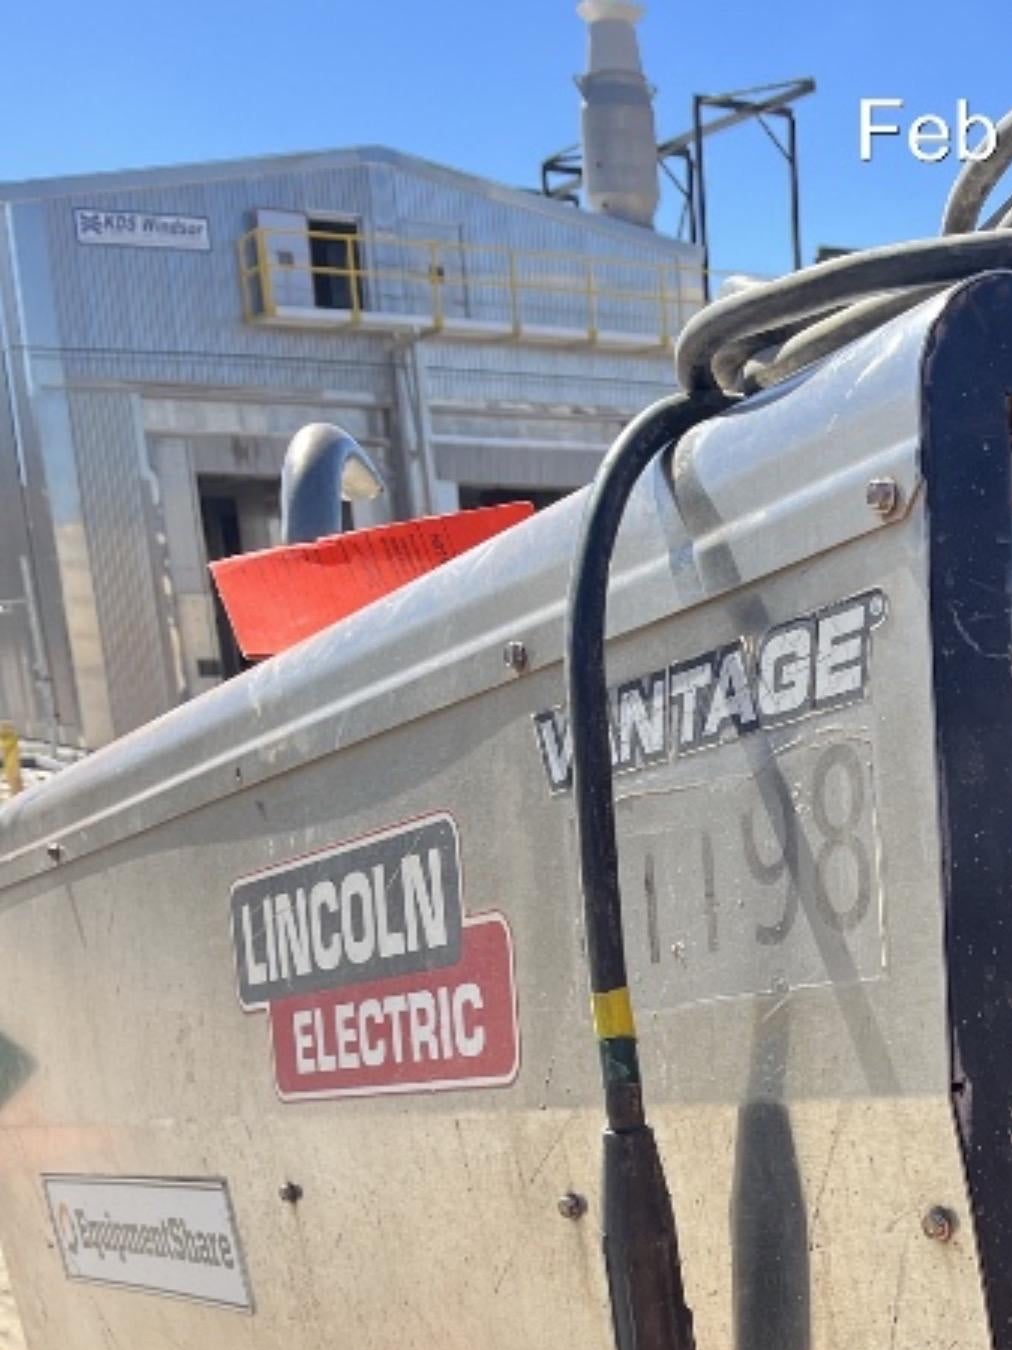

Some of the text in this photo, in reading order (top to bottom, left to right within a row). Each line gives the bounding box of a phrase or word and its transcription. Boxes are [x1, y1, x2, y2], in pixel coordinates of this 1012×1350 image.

[537, 603, 867, 787] VNTAGE
[241, 847, 449, 986] LINCOLN
[292, 983, 485, 1076] ELECTRIC
[74, 1208, 235, 1270] EquipmentShare
